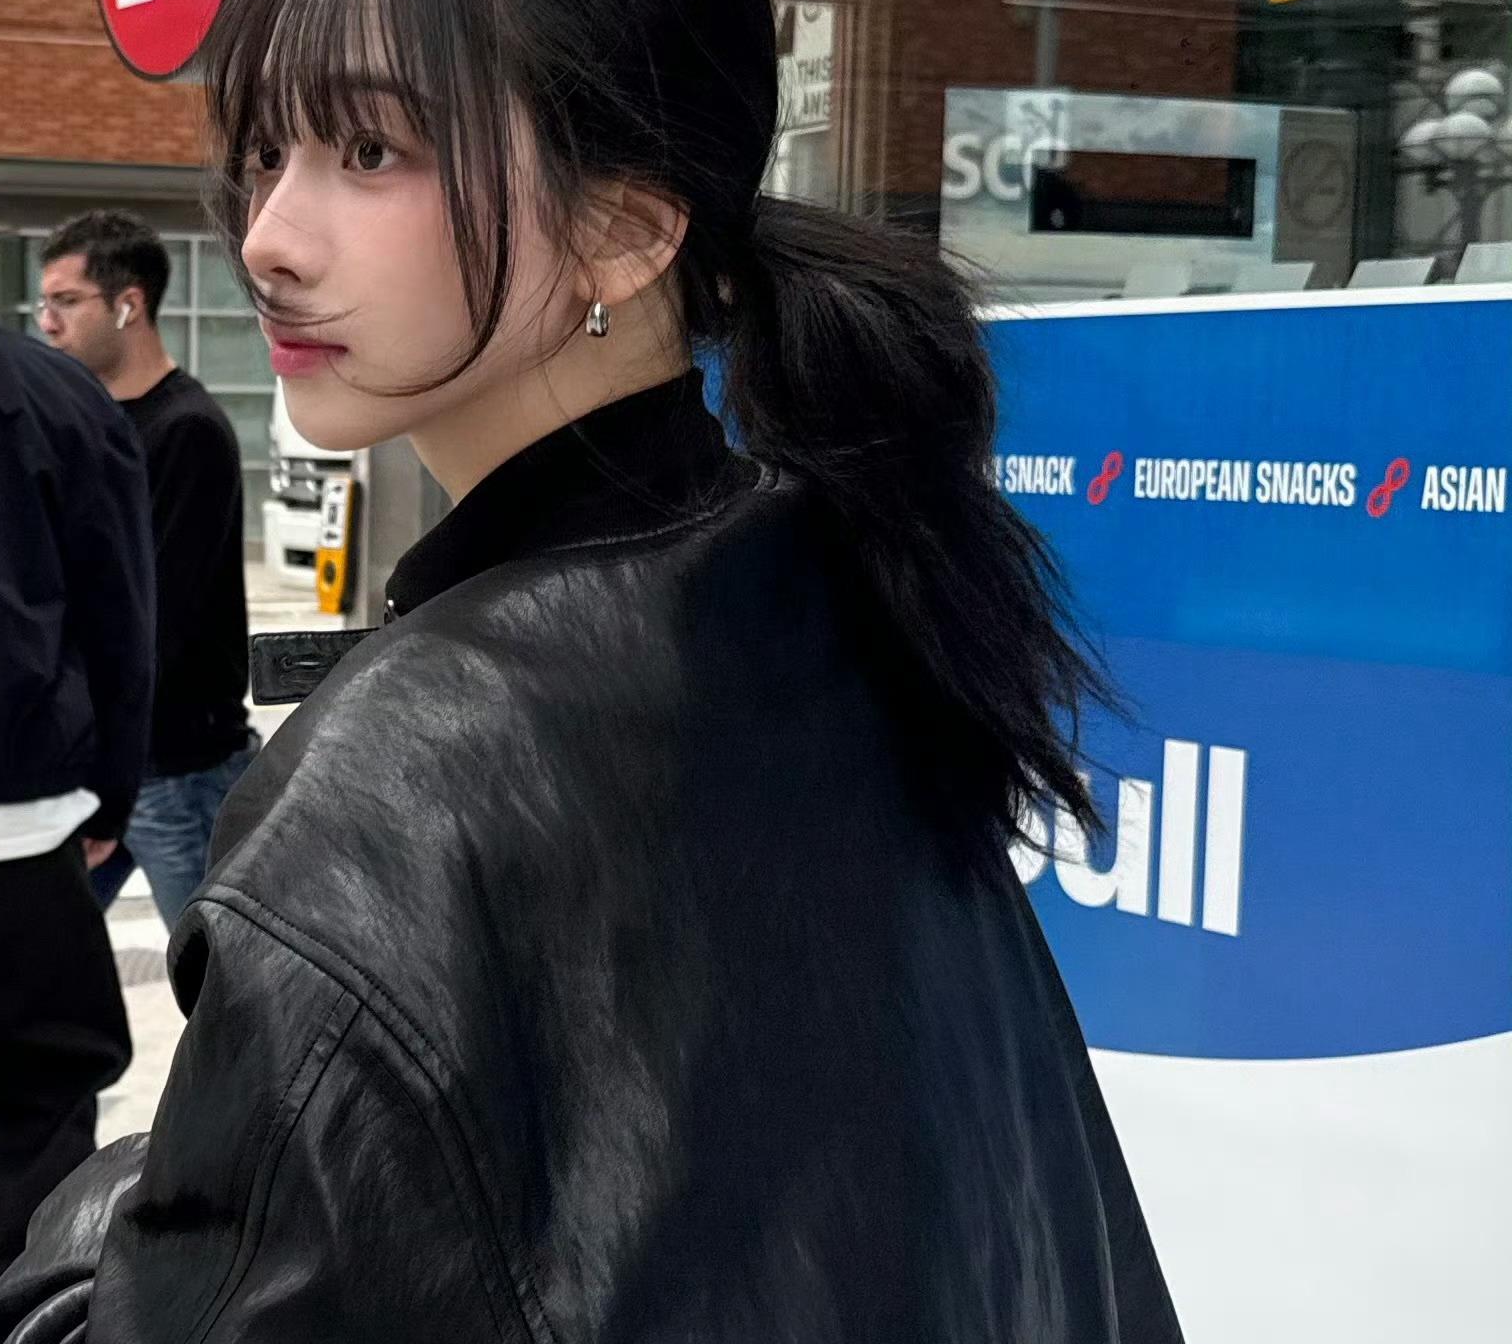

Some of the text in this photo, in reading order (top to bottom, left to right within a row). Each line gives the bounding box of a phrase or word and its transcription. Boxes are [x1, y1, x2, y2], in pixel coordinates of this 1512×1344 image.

[1004, 454, 1076, 496] SNACK
[1133, 457, 1252, 503] EUROPEAN
[1255, 460, 1357, 508] SNACKS
[1420, 464, 1508, 514] ASIAN
